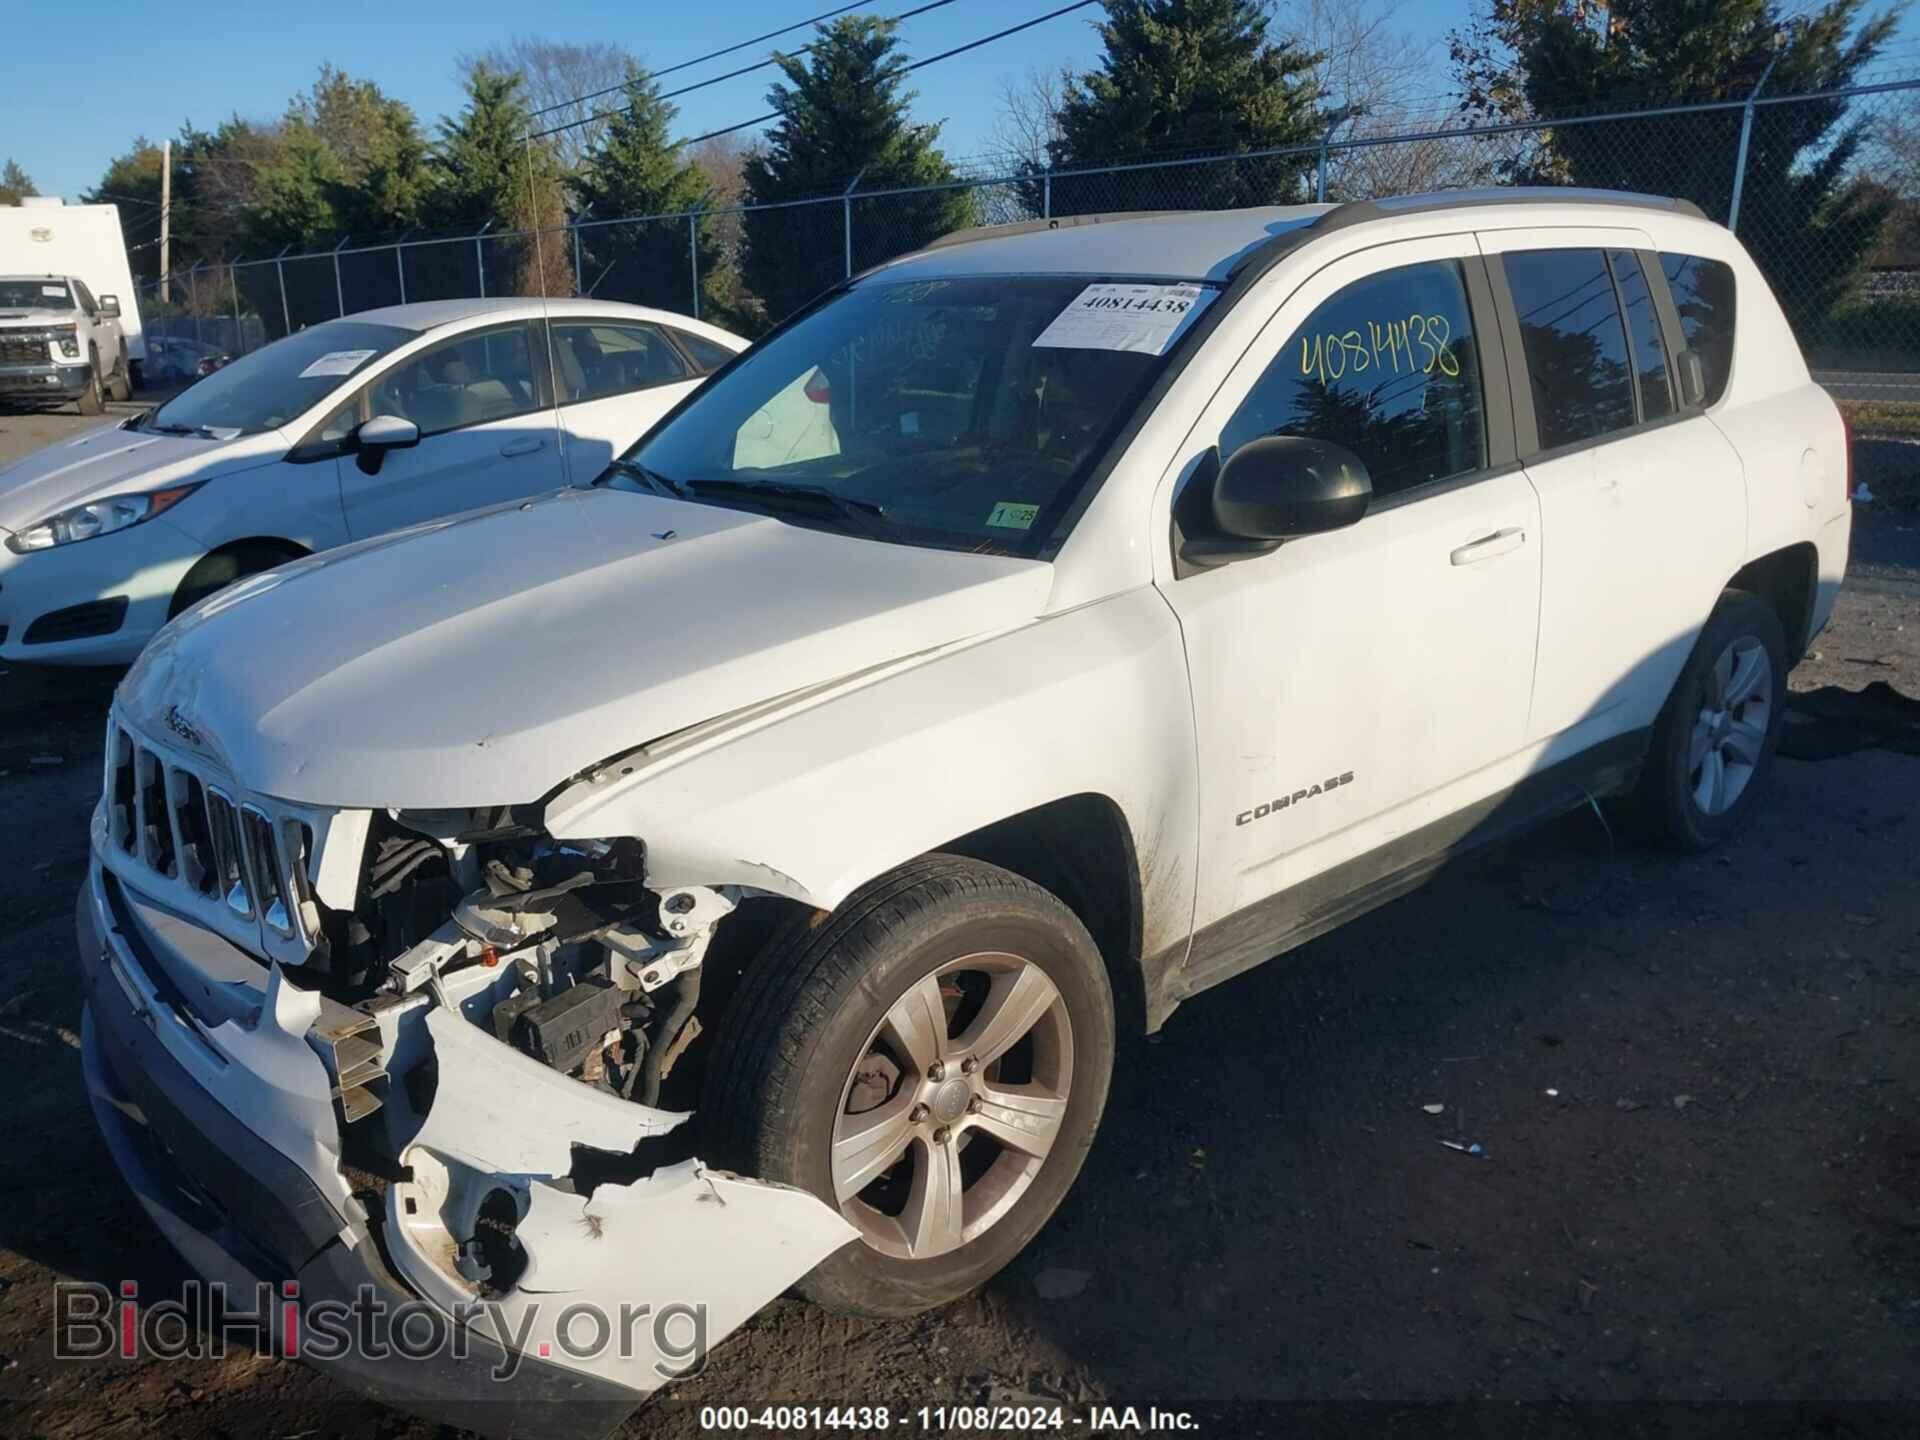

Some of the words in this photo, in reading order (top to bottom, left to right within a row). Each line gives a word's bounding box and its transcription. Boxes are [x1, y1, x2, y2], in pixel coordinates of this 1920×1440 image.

[1083, 296, 1190, 313] 40814438
[1302, 314, 1460, 386] 40814438
[1235, 770, 1354, 826] COMPASS
